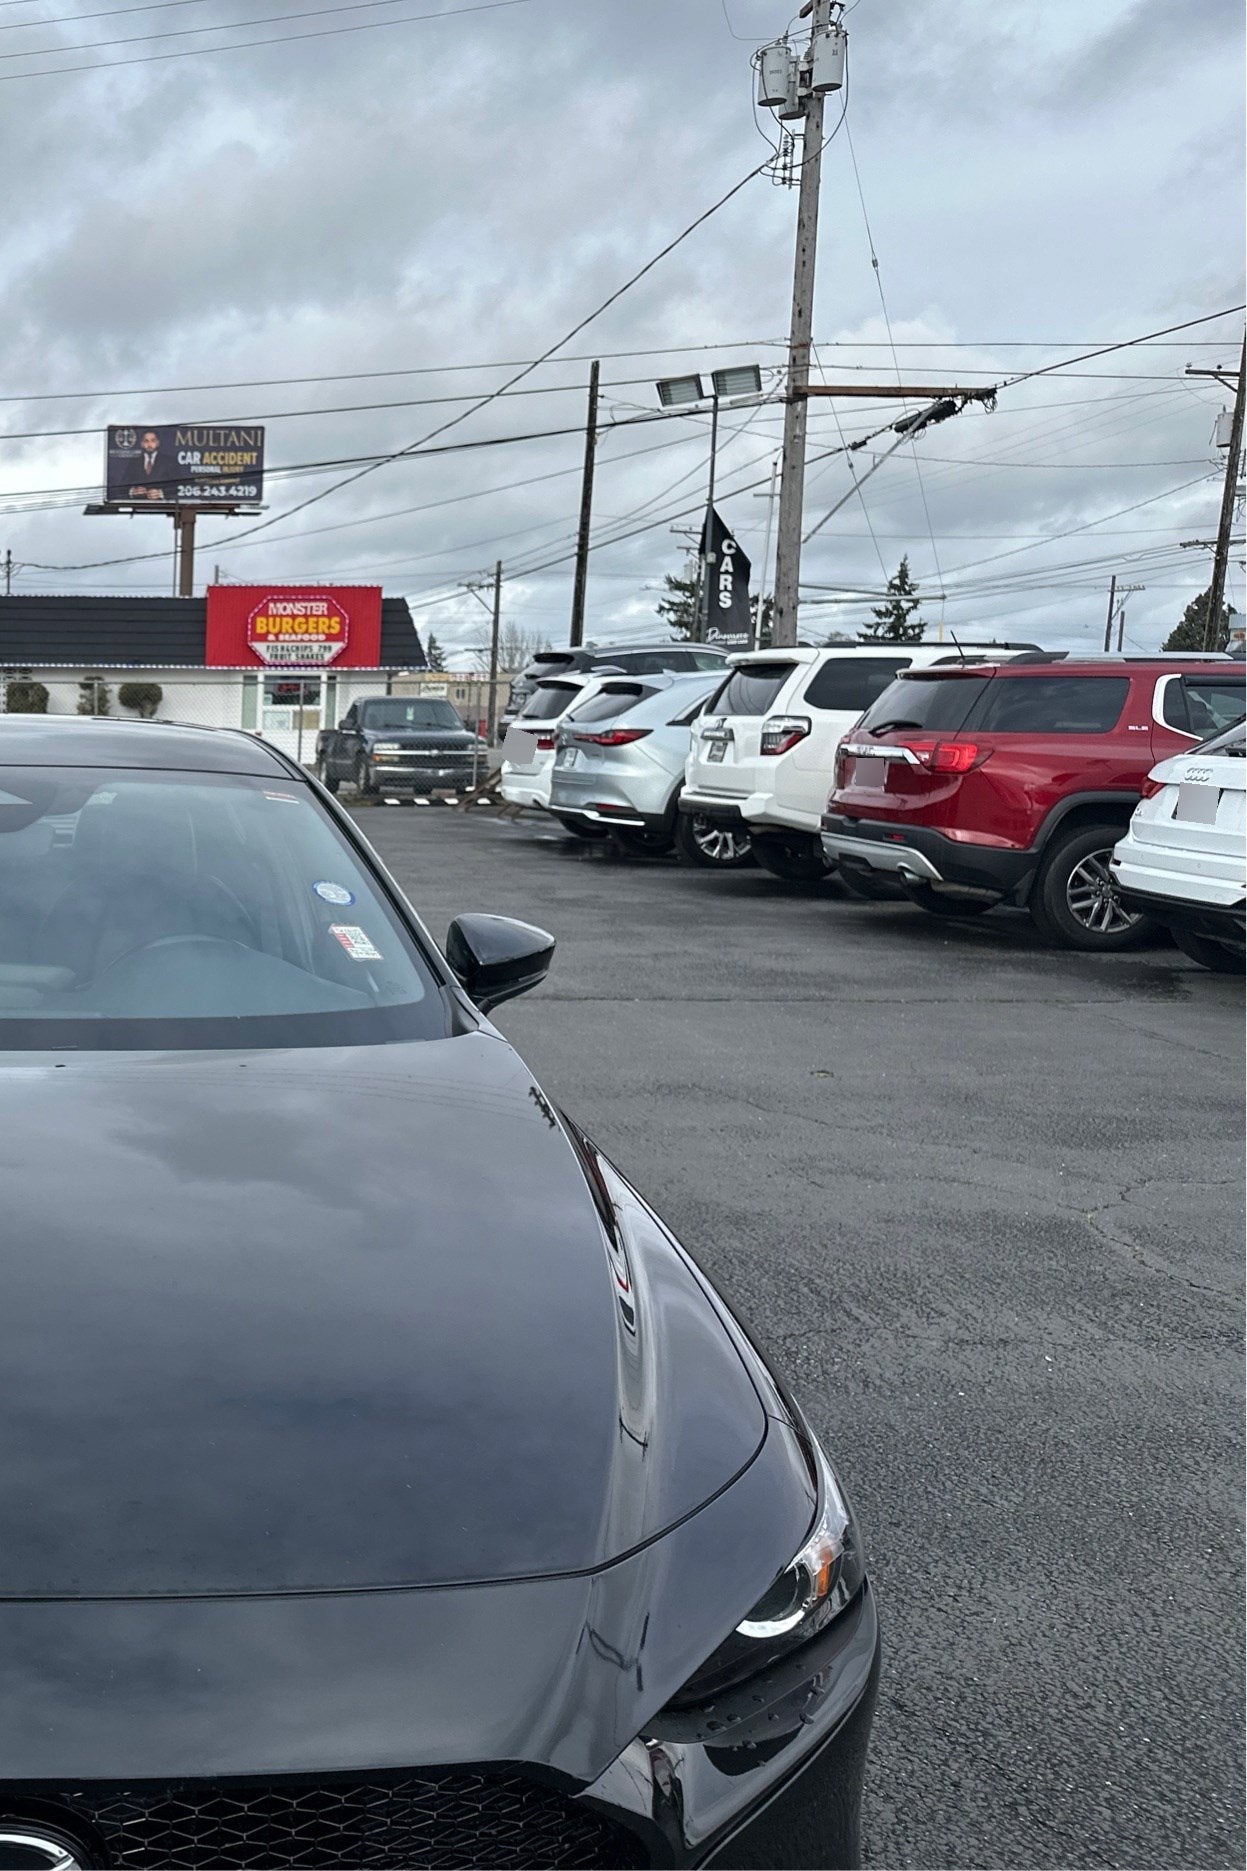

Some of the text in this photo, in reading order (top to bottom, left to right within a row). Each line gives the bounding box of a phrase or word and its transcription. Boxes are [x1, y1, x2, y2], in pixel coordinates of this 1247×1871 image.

[175, 430, 262, 447] MULTANI
[177, 451, 258, 465] CAR ACCIDENT
[177, 485, 257, 497] 206.243.4219
[719, 539, 736, 608] CARS
[269, 602, 328, 615] MONSTER
[256, 616, 340, 633] BURGERS
